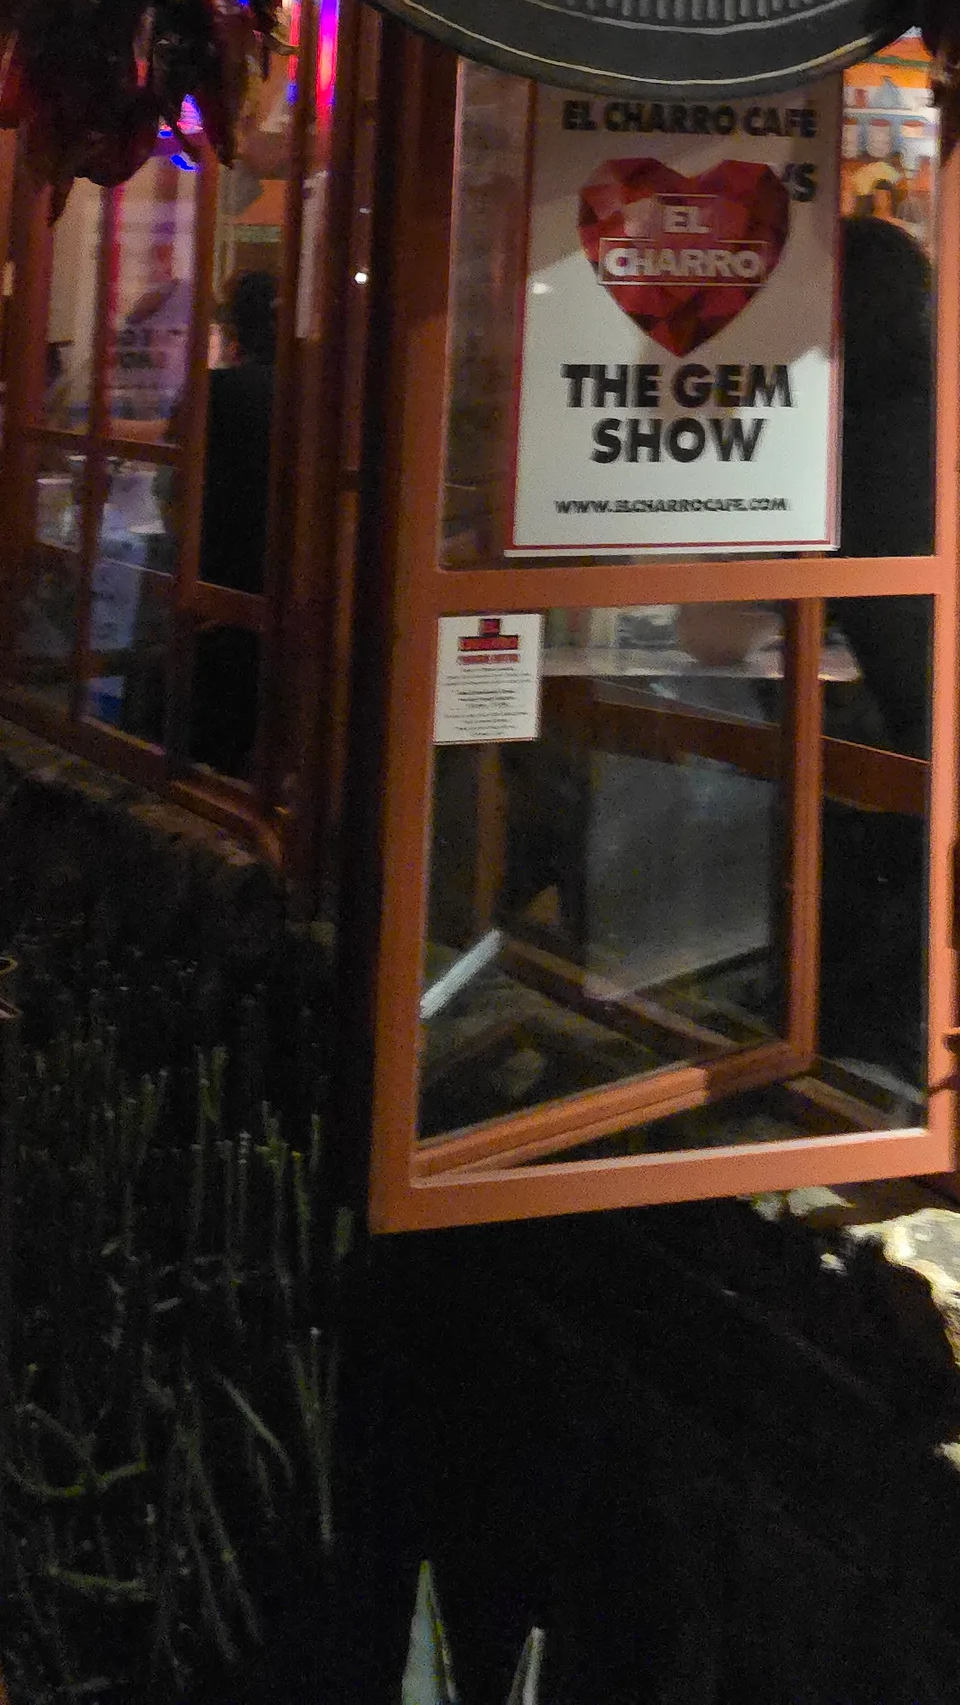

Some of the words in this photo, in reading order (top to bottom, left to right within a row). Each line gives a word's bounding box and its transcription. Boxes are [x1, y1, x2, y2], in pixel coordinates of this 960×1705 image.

[562, 99, 598, 131] EL
[603, 101, 737, 136] CHARRO
[745, 106, 818, 138] CAFE
[662, 205, 712, 234] EL
[603, 247, 762, 279] CHARRO
[560, 363, 661, 409] THE
[670, 363, 794, 409] GEM
[589, 417, 768, 465] SHOW
[554, 497, 790, 515] WWW.ELCHARROCAFE.COM
